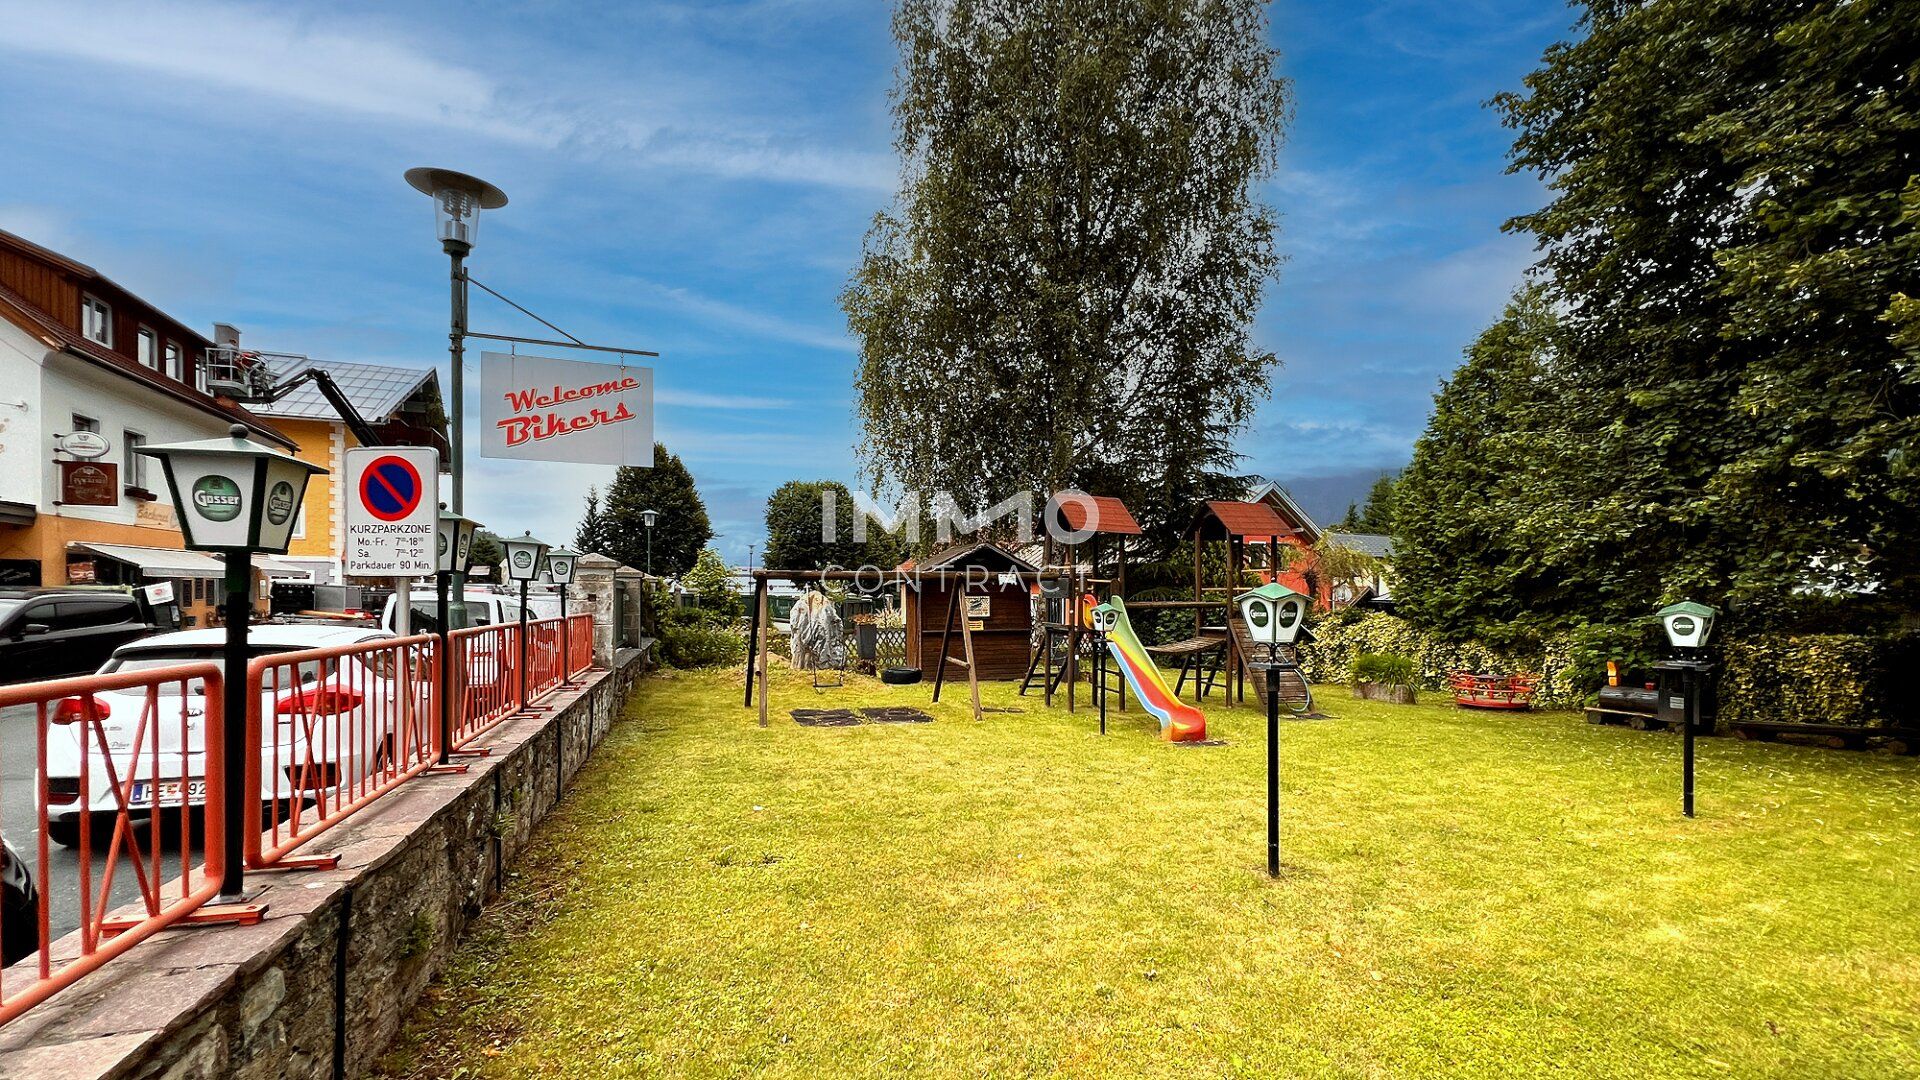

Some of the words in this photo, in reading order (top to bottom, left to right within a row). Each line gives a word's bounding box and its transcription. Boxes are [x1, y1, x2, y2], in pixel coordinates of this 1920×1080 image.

[504, 377, 640, 413] Welcome
[496, 402, 636, 447] Bikers
[350, 524, 432, 534] KURZPARKZONE
[357, 549, 371, 558] Sa.
[350, 561, 396, 570] Parkdauer
[400, 561, 411, 570] 90
[414, 561, 432, 570] Min.
